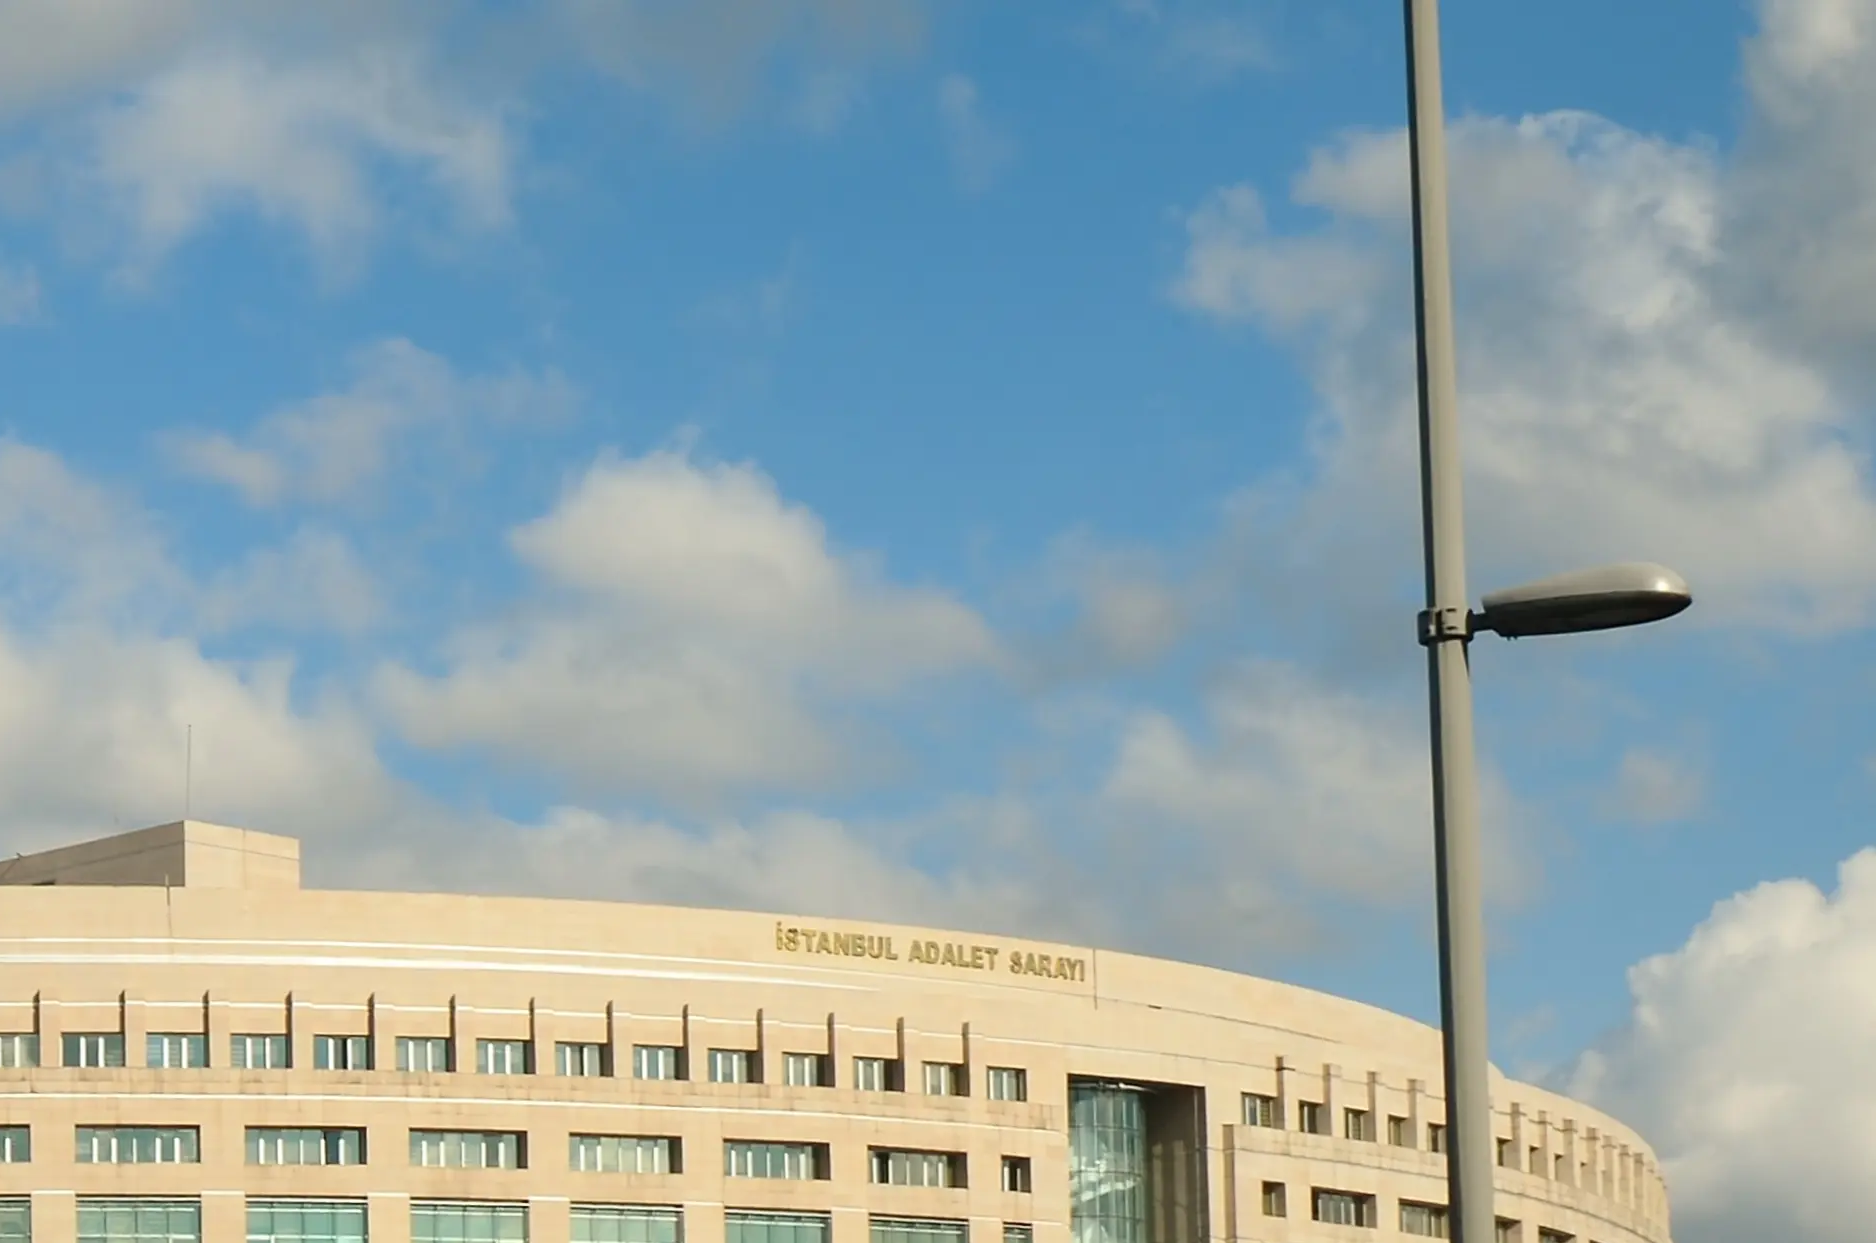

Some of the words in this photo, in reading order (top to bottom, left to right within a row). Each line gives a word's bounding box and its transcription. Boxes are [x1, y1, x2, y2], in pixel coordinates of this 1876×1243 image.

[775, 920, 898, 961] İSTANBUL
[907, 938, 999, 971] ADALET
[1008, 950, 1086, 982] SARAYI
